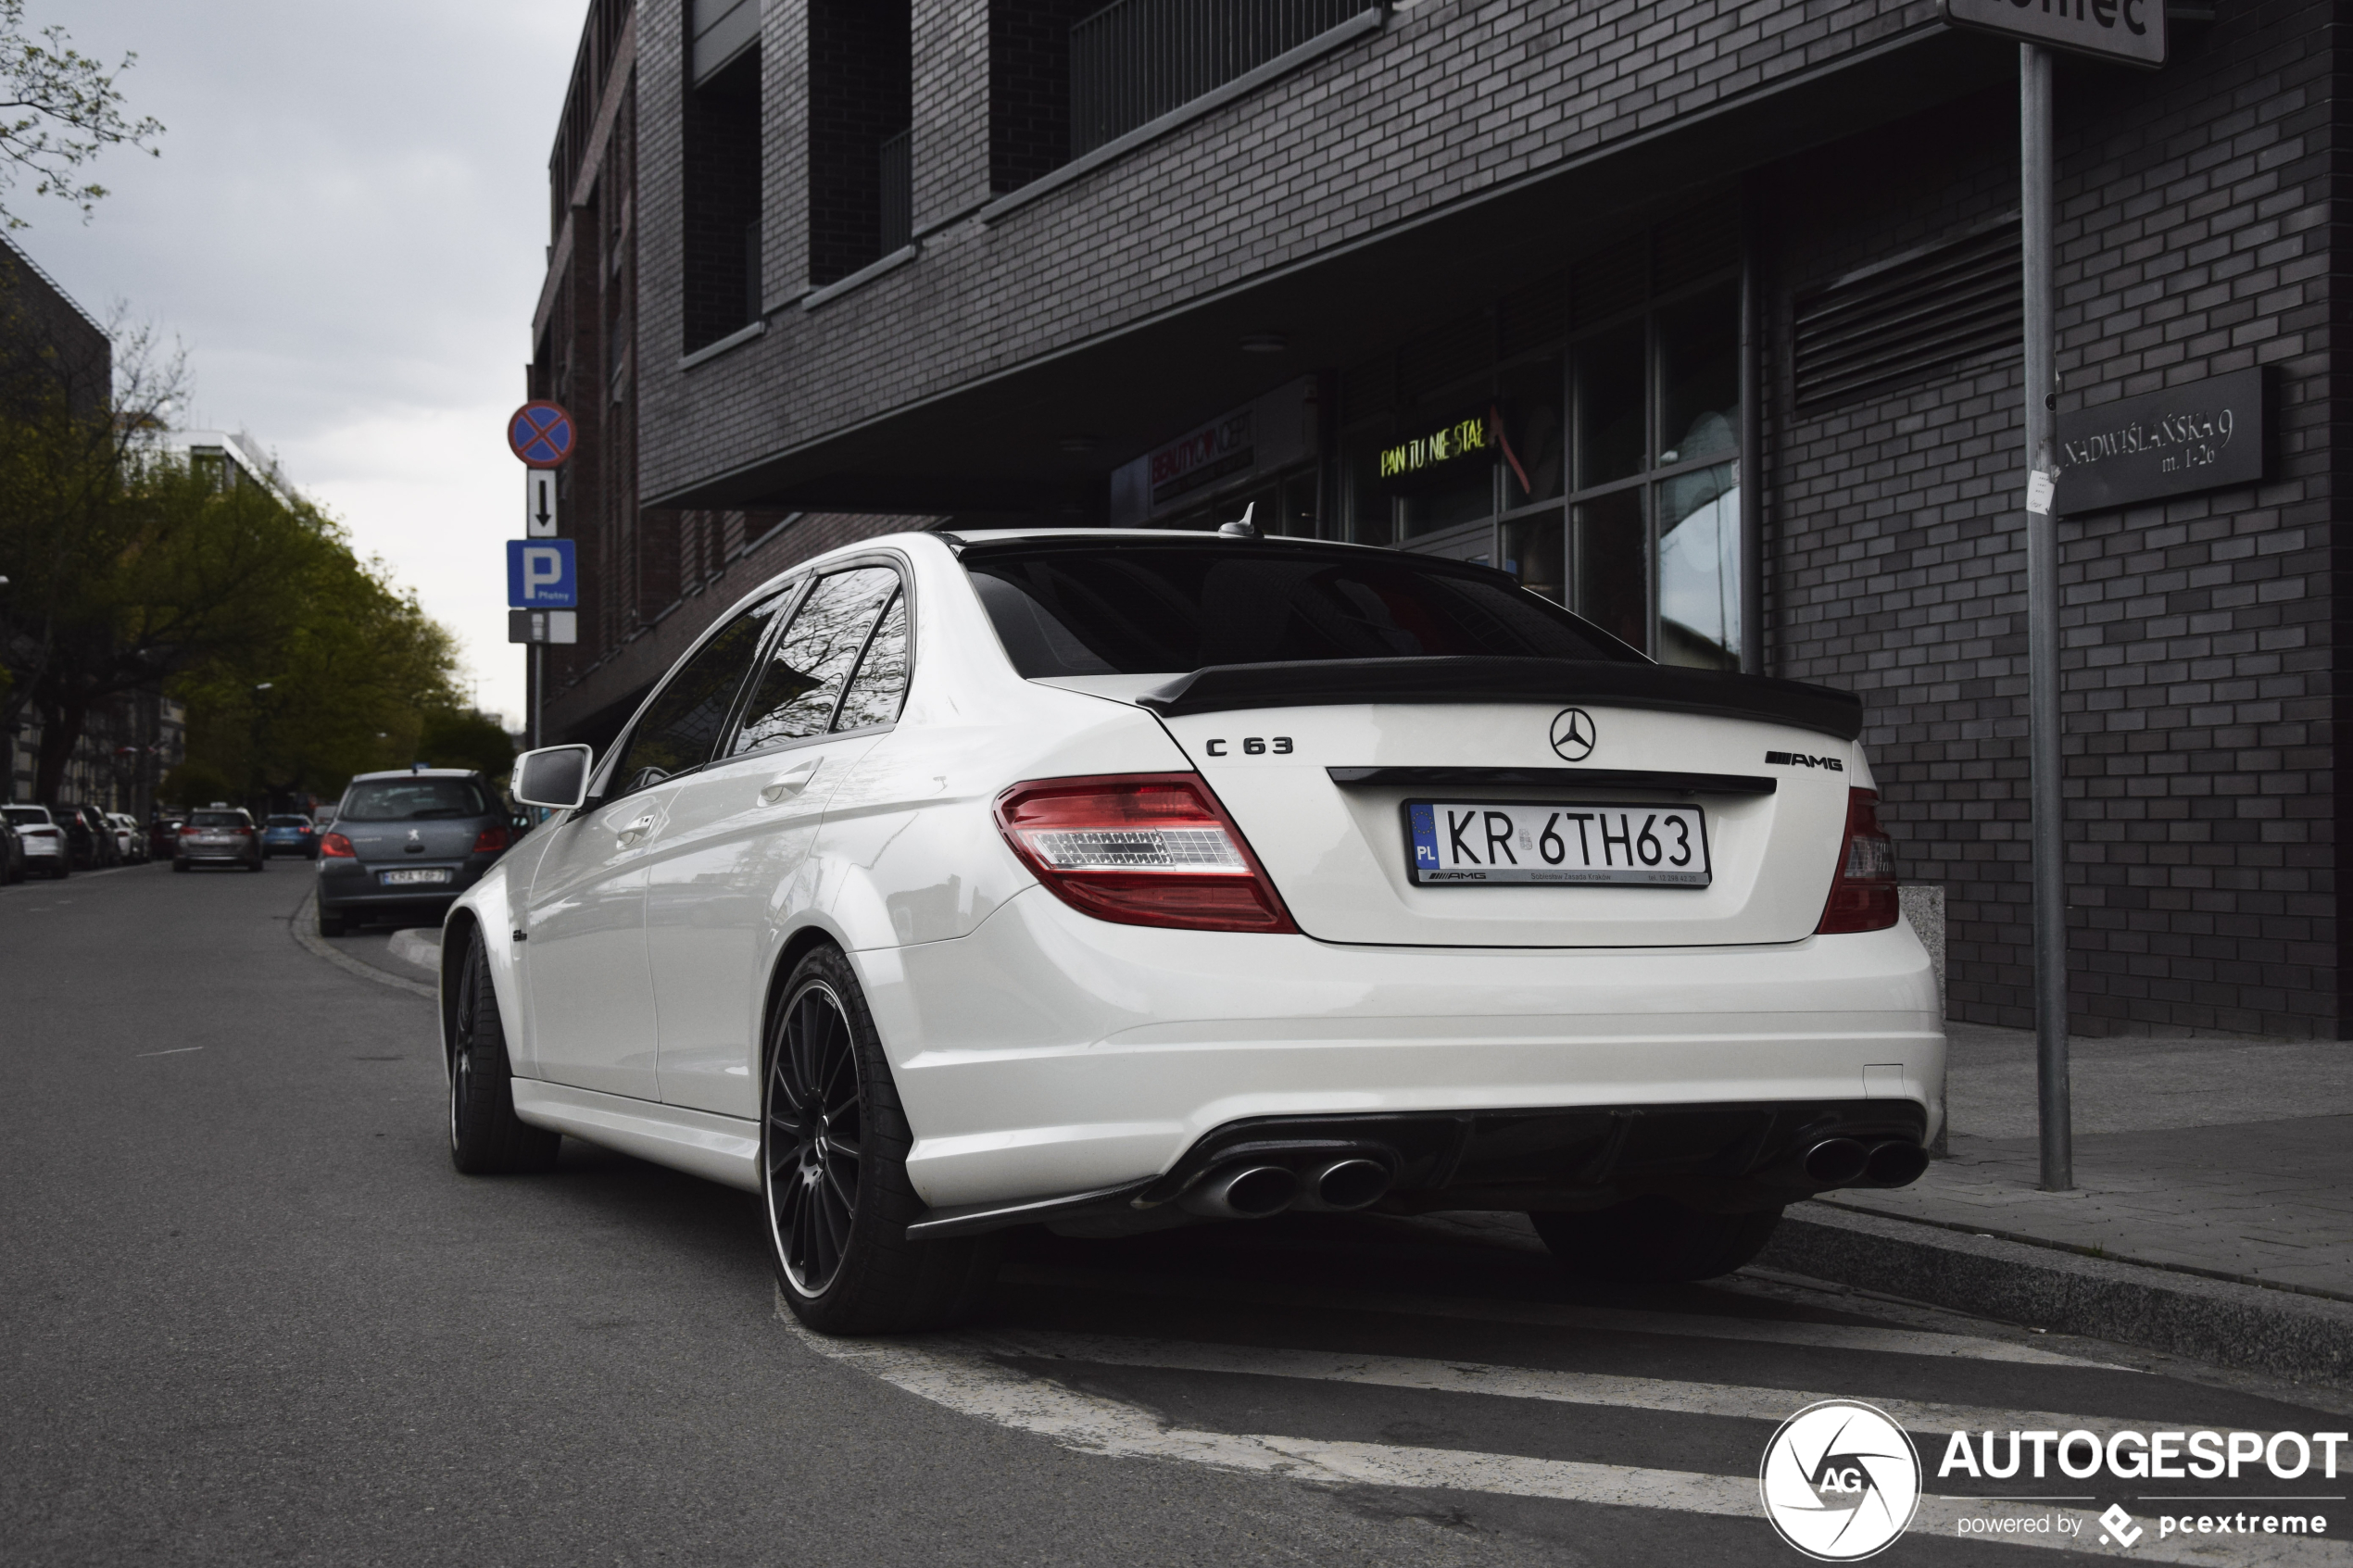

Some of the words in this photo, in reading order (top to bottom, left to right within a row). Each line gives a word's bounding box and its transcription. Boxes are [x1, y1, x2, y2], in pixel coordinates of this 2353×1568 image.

[2064, 411, 2214, 467] NADWIŚLAŃSKA
[2218, 408, 2233, 449] 9
[1380, 444, 1406, 478] PAN
[1409, 438, 1426, 470] TU
[1429, 428, 1450, 463] NIE
[2161, 455, 2180, 473] m.
[2184, 443, 2216, 469] 1-26
[523, 546, 561, 599] P
[1206, 738, 1227, 757] C
[1243, 736, 1293, 755] 63
[1791, 753, 1843, 771] AMG
[1416, 846, 1436, 861] PL
[1447, 810, 1518, 865] KR
[1539, 812, 1692, 867] 6TH63
[1564, 872, 1588, 881] Zasada
[1588, 872, 1611, 881] Kraków
